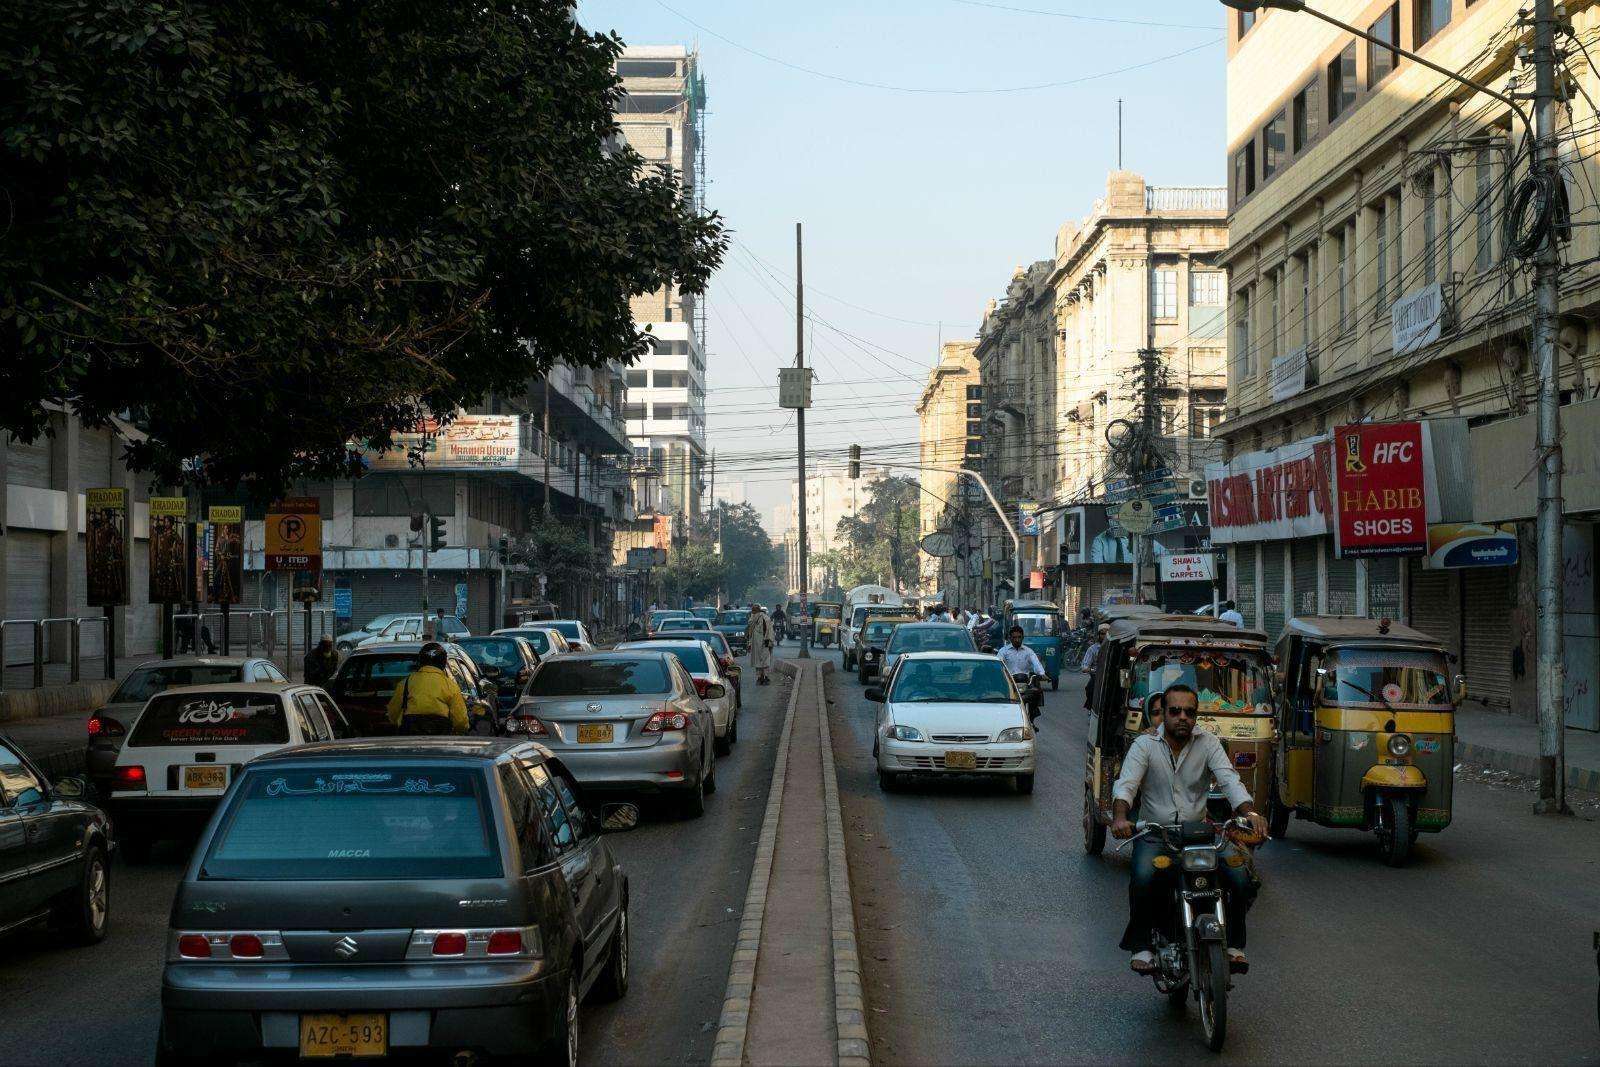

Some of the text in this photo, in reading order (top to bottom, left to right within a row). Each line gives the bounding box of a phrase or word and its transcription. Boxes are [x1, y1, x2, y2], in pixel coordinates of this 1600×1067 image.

[1373, 441, 1413, 464] HFC
[88, 492, 122, 502] KHADDAR
[1344, 488, 1422, 512] HABIB
[152, 501, 184, 510] KHADDAR
[210, 509, 240, 518] KHADDAR
[1353, 518, 1413, 536] SHOES
[1172, 557, 1201, 565] SHAWLS
[204, 727, 248, 737] POWER
[328, 849, 370, 858] MACCA
[307, 1025, 383, 1044] AZC-593
